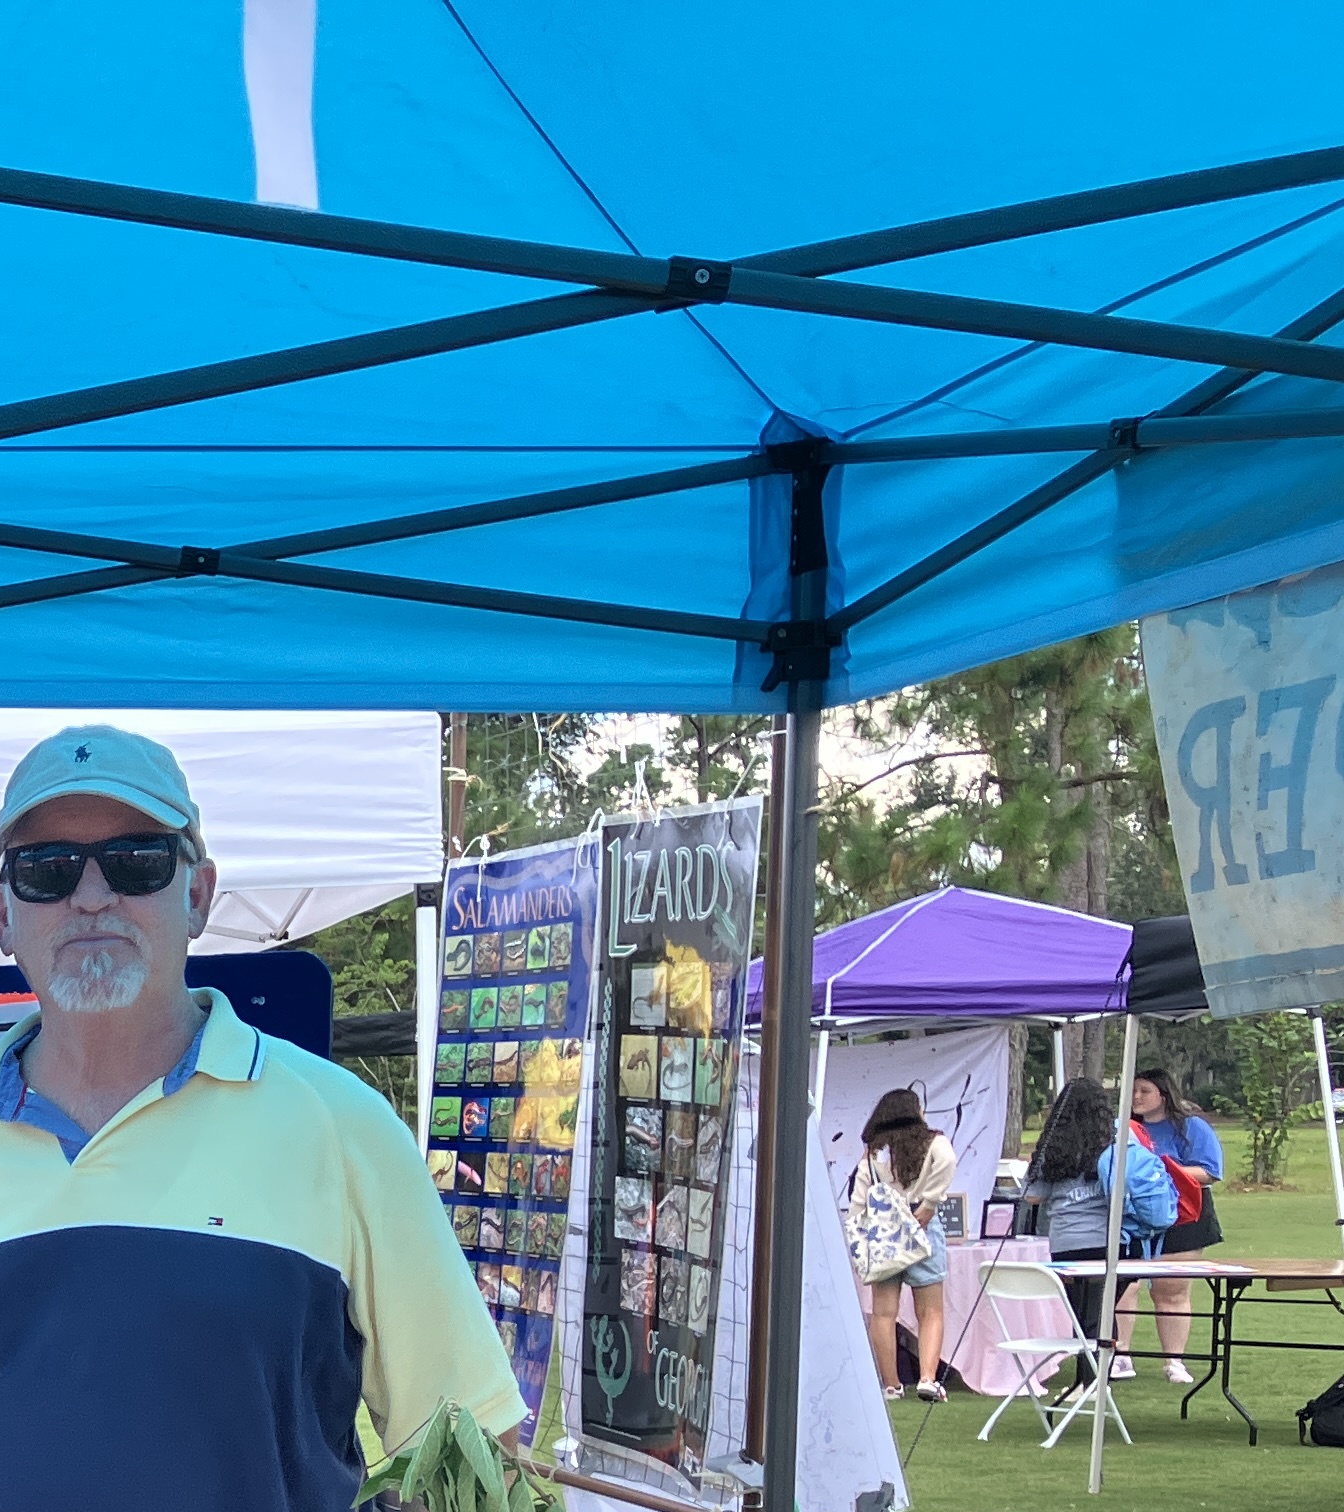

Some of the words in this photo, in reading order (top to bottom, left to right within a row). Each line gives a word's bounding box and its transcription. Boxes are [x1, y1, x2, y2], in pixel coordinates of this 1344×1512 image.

[452, 885, 573, 931] SALAMANDERS
[607, 837, 734, 958] LIZARDS
[647, 1329, 659, 1355] OF
